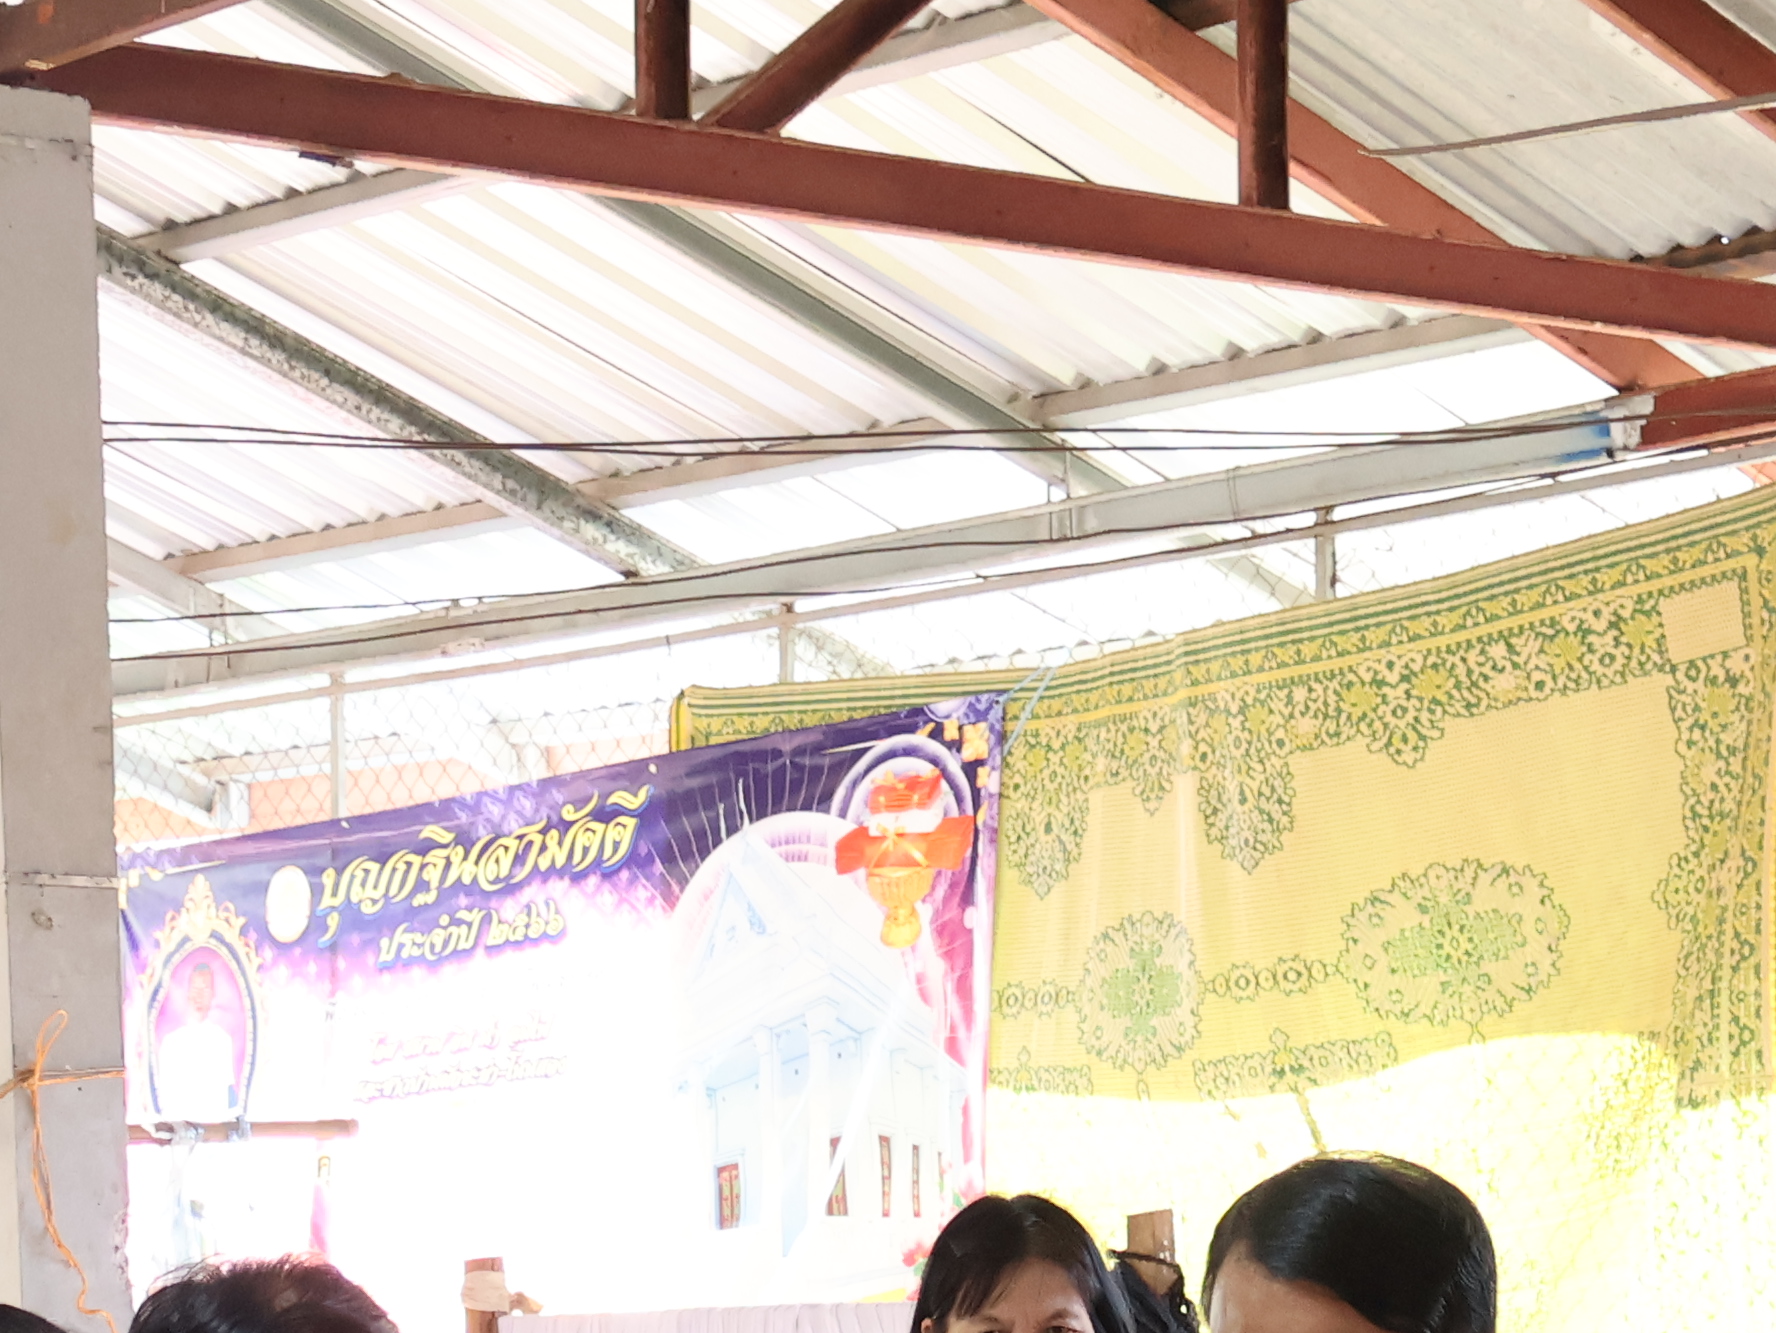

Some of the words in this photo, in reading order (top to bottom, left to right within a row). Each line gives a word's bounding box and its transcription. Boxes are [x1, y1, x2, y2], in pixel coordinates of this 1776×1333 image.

[315, 785, 654, 947] บุญกฐินสามัคคี
[377, 908, 486, 968] ประจำปี
